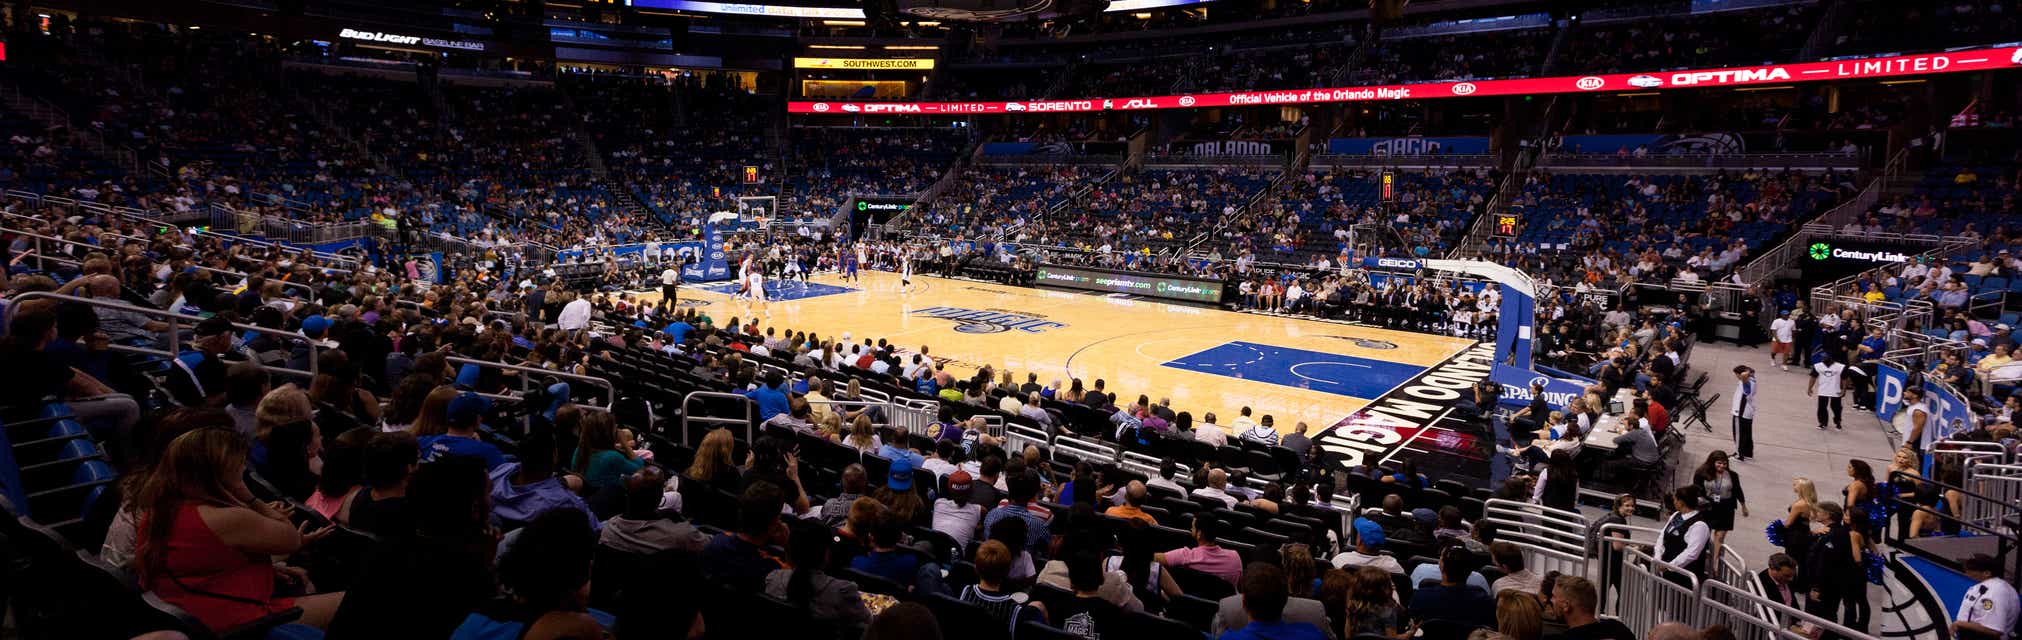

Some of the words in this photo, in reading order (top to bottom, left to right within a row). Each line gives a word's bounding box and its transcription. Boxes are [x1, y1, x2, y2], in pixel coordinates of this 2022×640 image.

[465, 42, 484, 50] BAR
[843, 60, 917, 68] SOUTHWEST.COM
[1671, 67, 1791, 86] OPTIMA
[1838, 56, 1949, 76] LIMITED
[1579, 77, 1601, 89] KIA
[1454, 84, 1474, 94] KIA
[1229, 93, 1262, 104] Official
[1264, 92, 1297, 103] Vehicle
[1300, 90, 1310, 101] of
[1312, 90, 1330, 101] the
[1333, 88, 1374, 100] Orlando
[1378, 87, 1410, 99] Magic
[865, 104, 921, 112] OPTIMA
[940, 104, 984, 112] LIMITED
[1029, 101, 1091, 111] SORENTO
[1194, 141, 1271, 157] ORLANDO
[1833, 248, 1909, 262] CenturyLink
[1378, 258, 1416, 268] GEICO
[1500, 383, 1577, 407] SPADING
